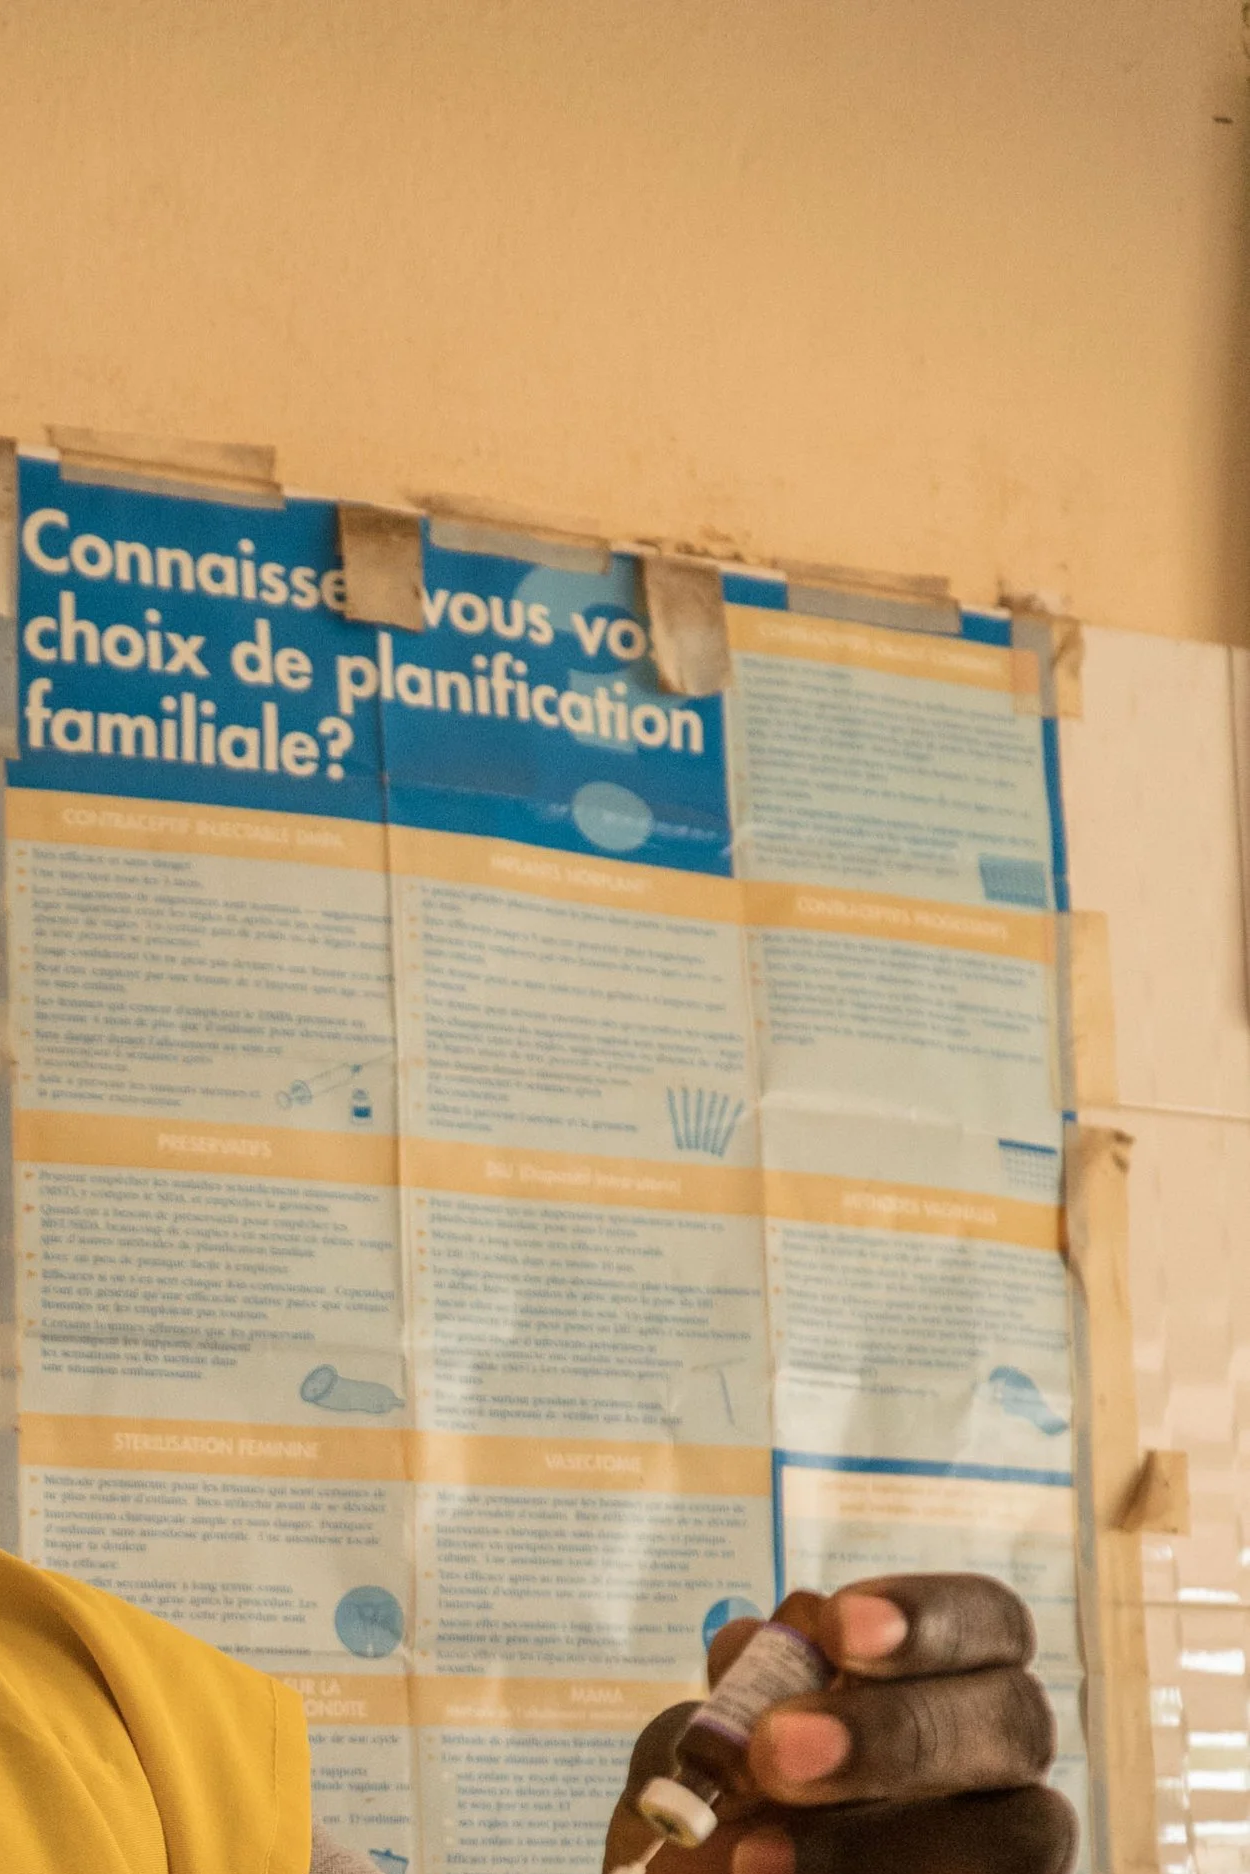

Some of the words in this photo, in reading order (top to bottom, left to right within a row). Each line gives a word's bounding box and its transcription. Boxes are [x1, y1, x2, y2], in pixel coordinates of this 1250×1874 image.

[21, 507, 347, 612] Connaisse
[423, 585, 554, 647] vous
[570, 611, 649, 662] vo
[23, 592, 209, 678] choix
[230, 619, 313, 690] de
[336, 630, 704, 753] planification
[24, 679, 355, 782] familiale?
